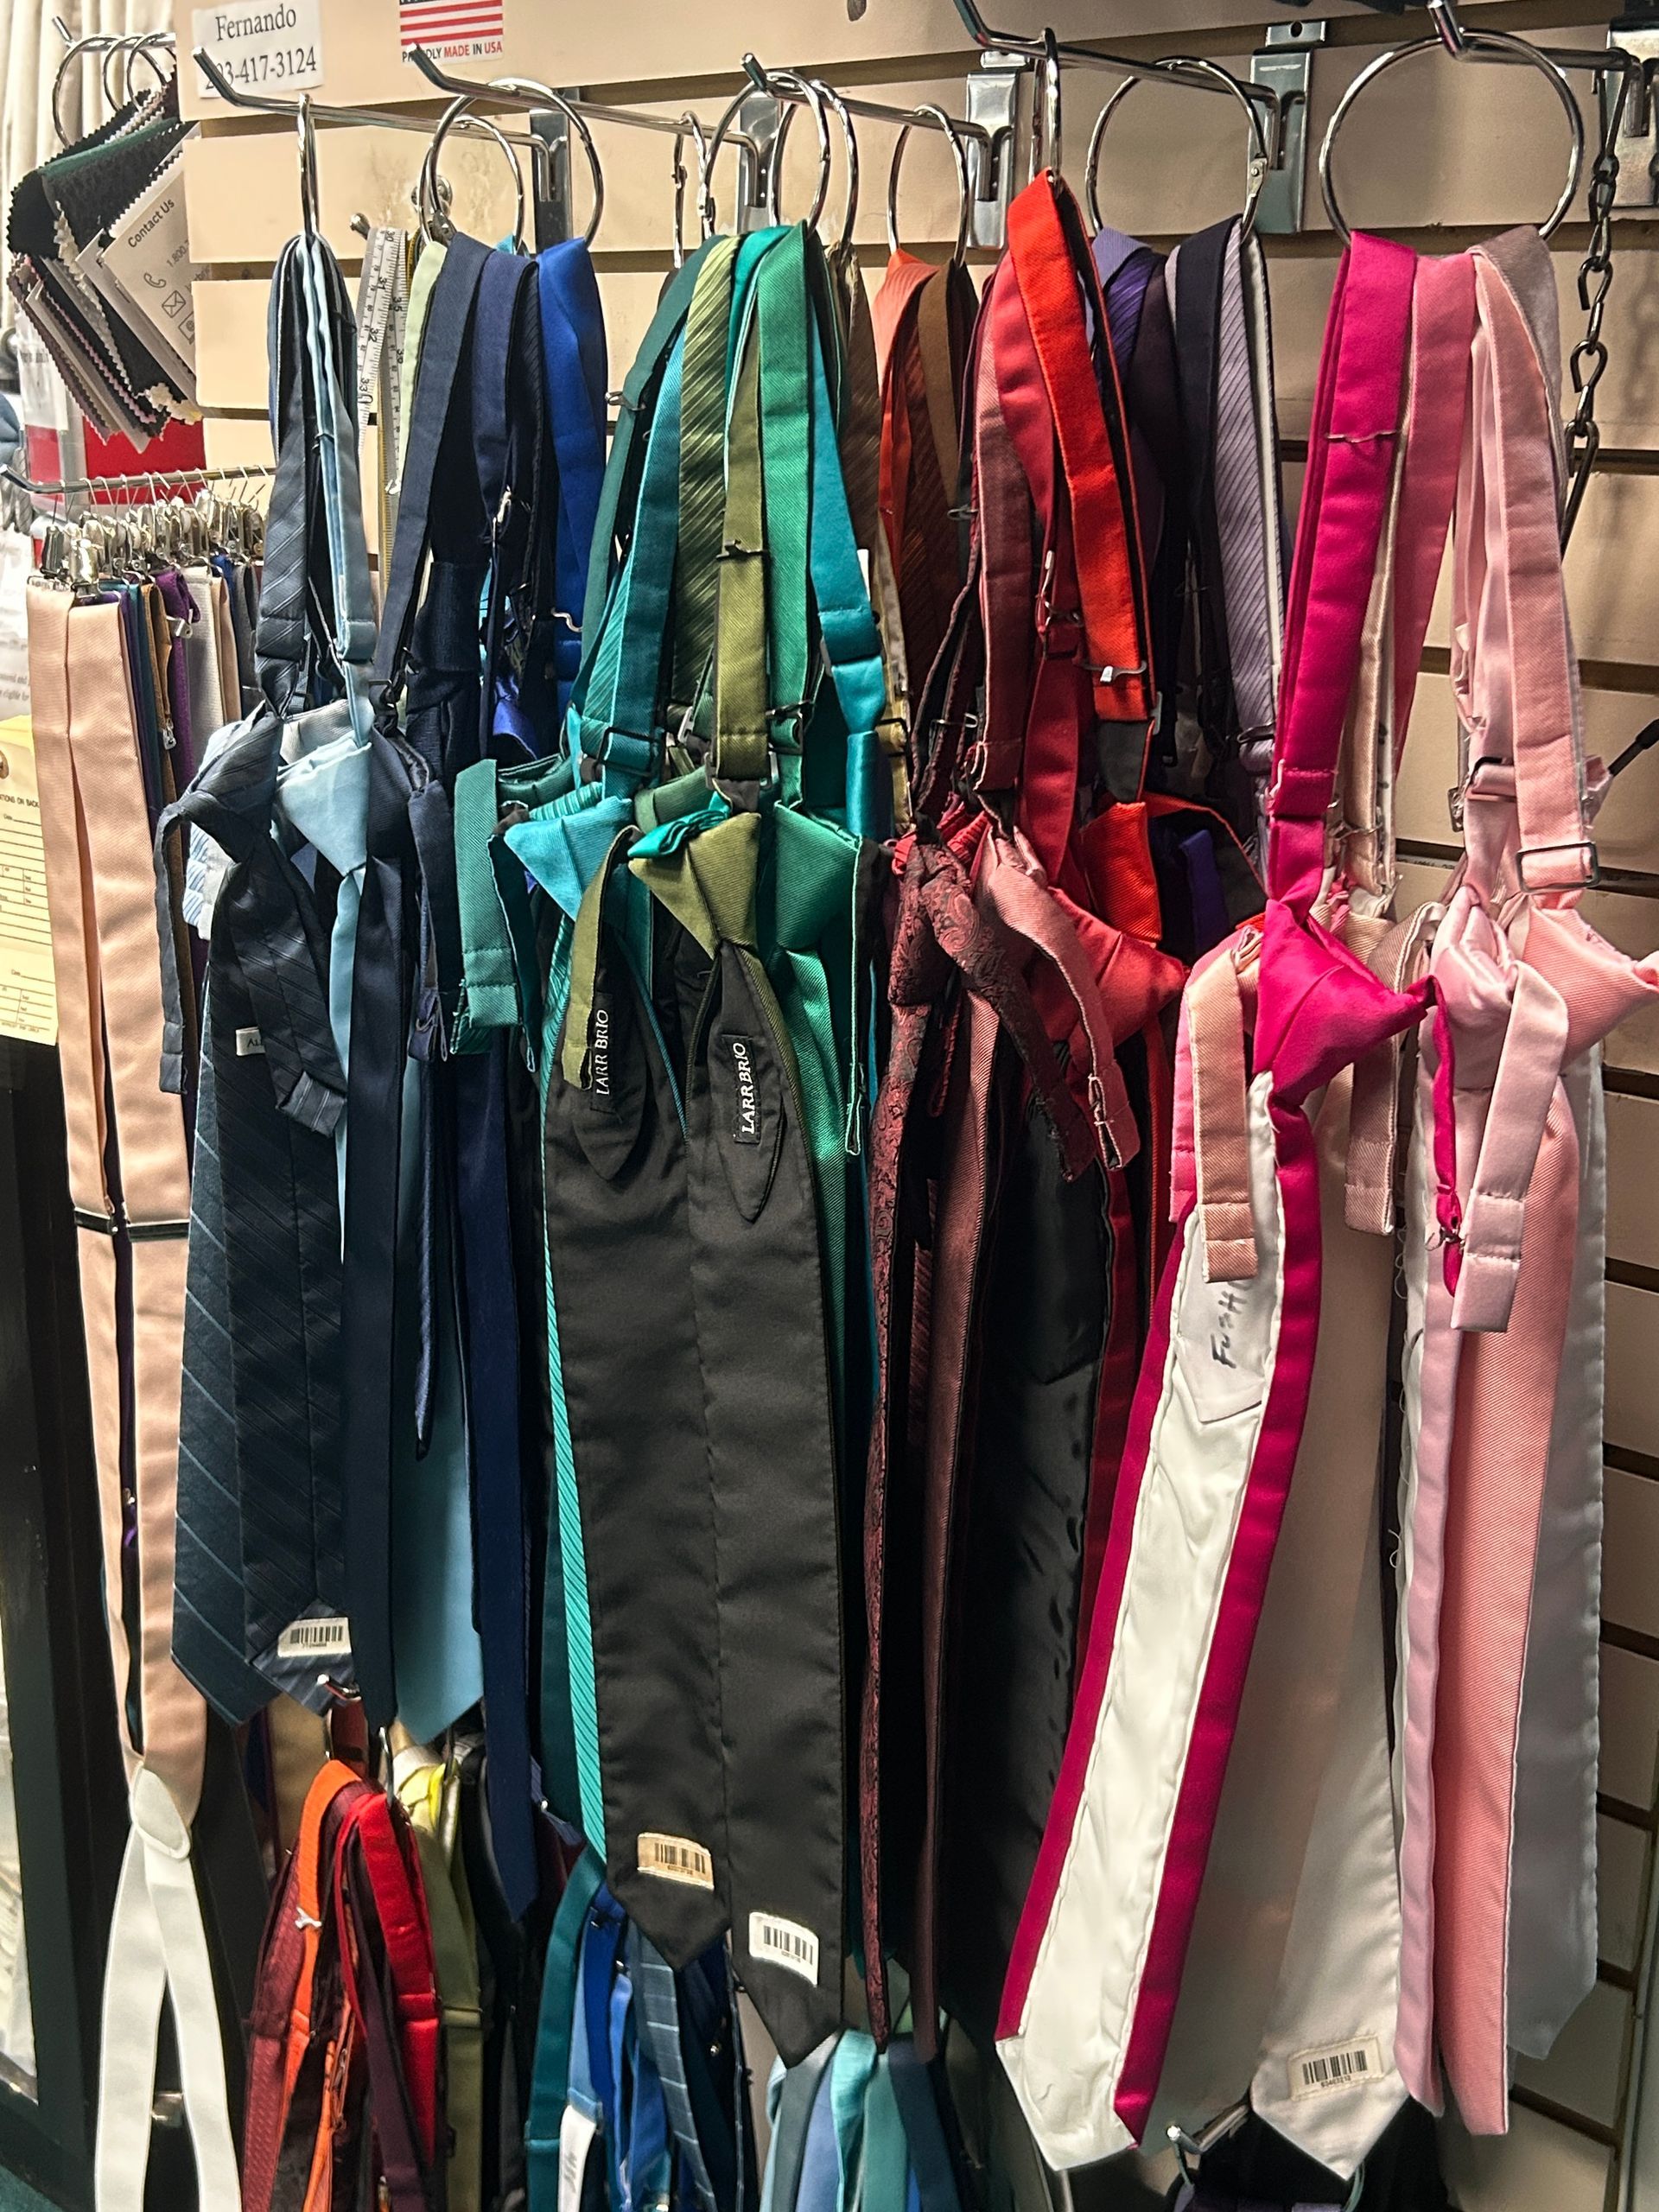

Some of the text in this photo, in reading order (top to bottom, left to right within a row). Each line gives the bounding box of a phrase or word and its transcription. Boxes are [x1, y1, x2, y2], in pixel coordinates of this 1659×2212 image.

[215, 3, 296, 41] Fernando
[443, 44, 471, 58] MADE
[473, 43, 482, 55] IN
[484, 41, 503, 54] USA
[128, 199, 175, 248] Contact Us
[594, 1009, 610, 1096] LARR BRIO
[733, 1042, 756, 1135] LARR BRIO
